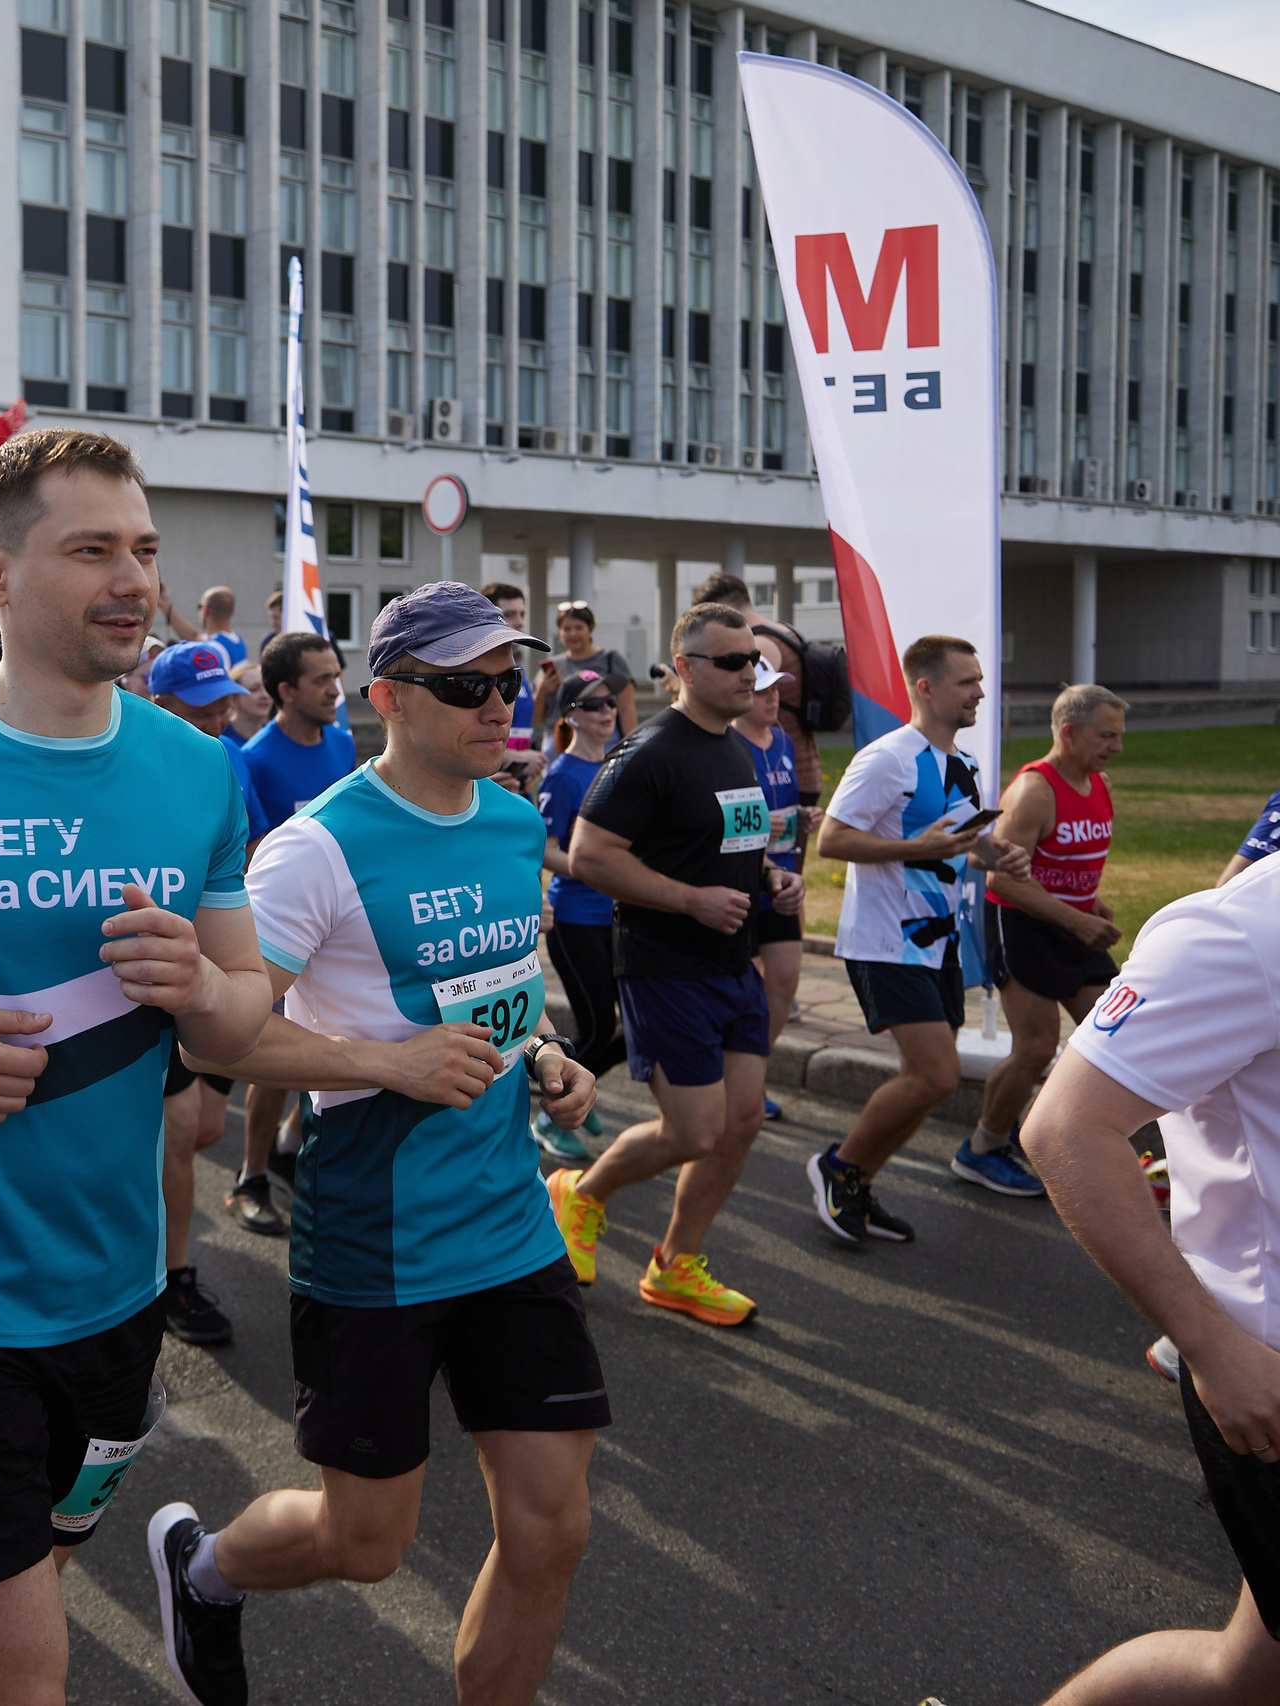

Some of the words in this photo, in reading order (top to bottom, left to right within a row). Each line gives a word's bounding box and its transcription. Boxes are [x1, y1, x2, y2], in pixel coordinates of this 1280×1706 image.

[733, 805, 762, 834] 545
[27, 867, 186, 909] СИБУР
[408, 883, 484, 925] БЕГУ
[417, 938, 455, 967] за
[458, 914, 541, 958] СИБУР
[471, 990, 529, 1048] 592
